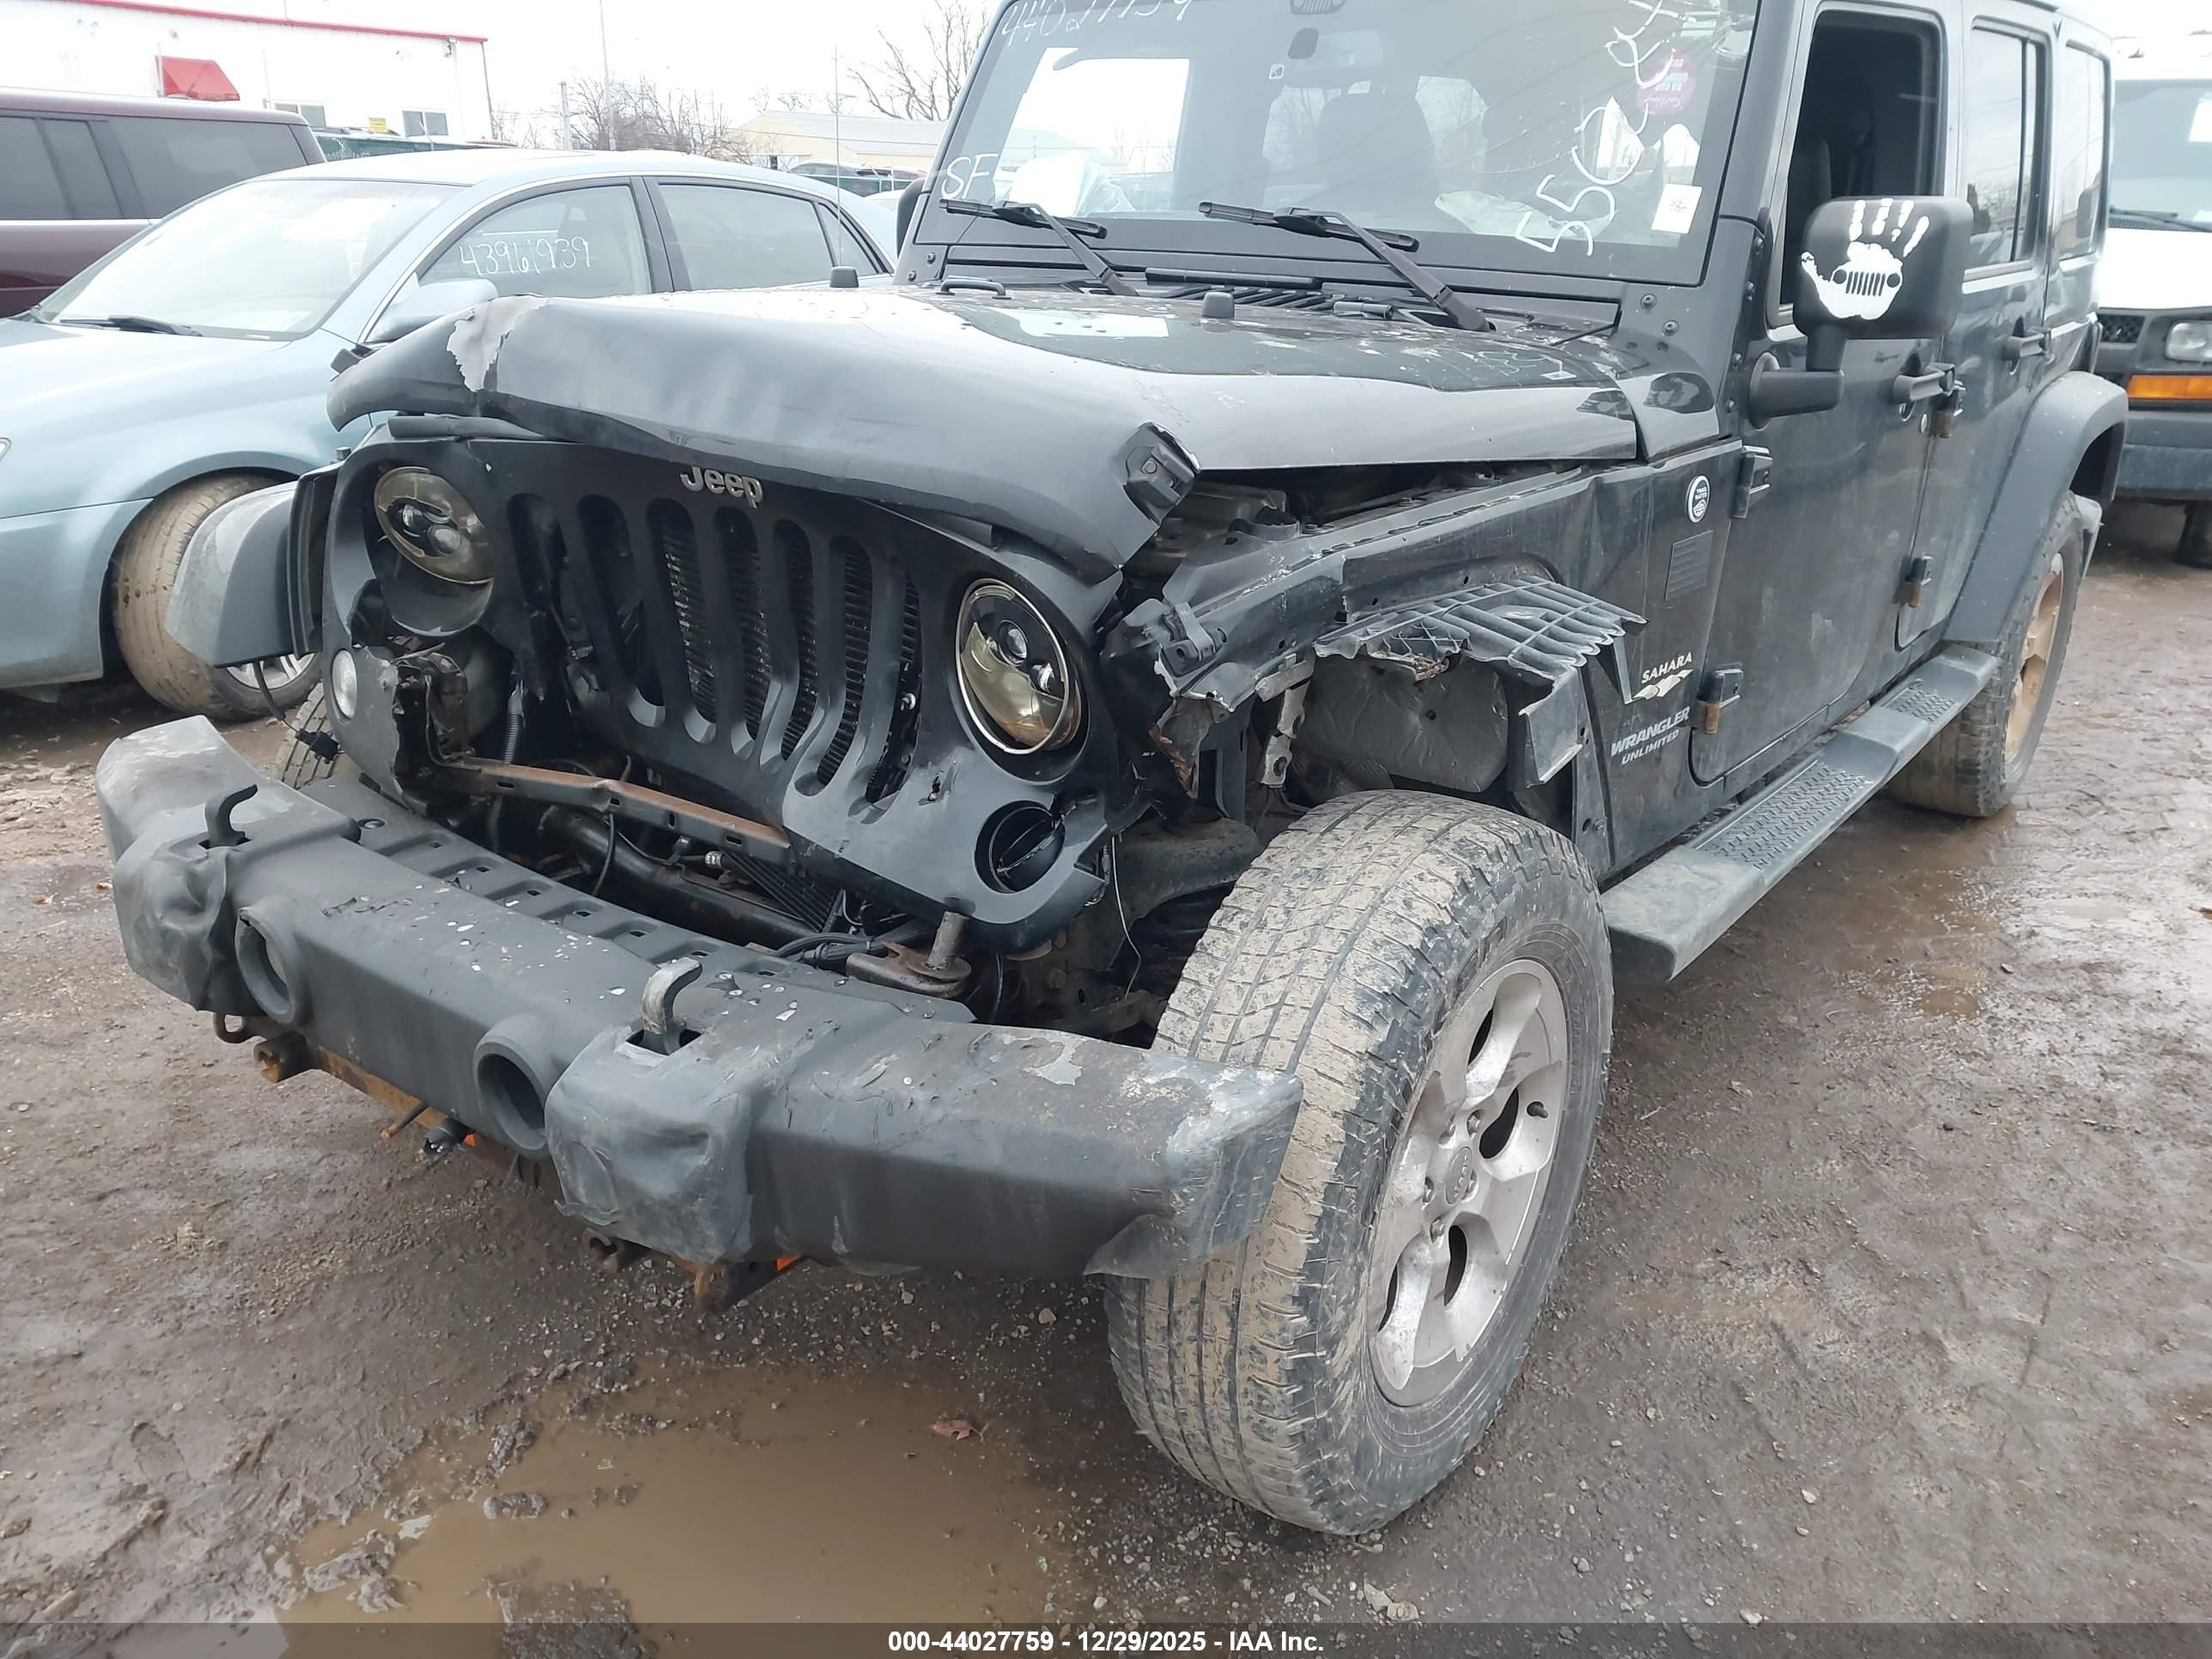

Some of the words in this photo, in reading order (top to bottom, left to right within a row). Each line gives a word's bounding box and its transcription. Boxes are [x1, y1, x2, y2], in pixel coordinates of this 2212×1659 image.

[941, 153, 999, 200] SF
[459, 236, 591, 276] 43961939
[679, 466, 763, 509] Jeep
[1641, 652, 1693, 684] SAHARA
[1611, 706, 1691, 757] WRANGLER
[1620, 729, 1680, 766] UNLIMITED
